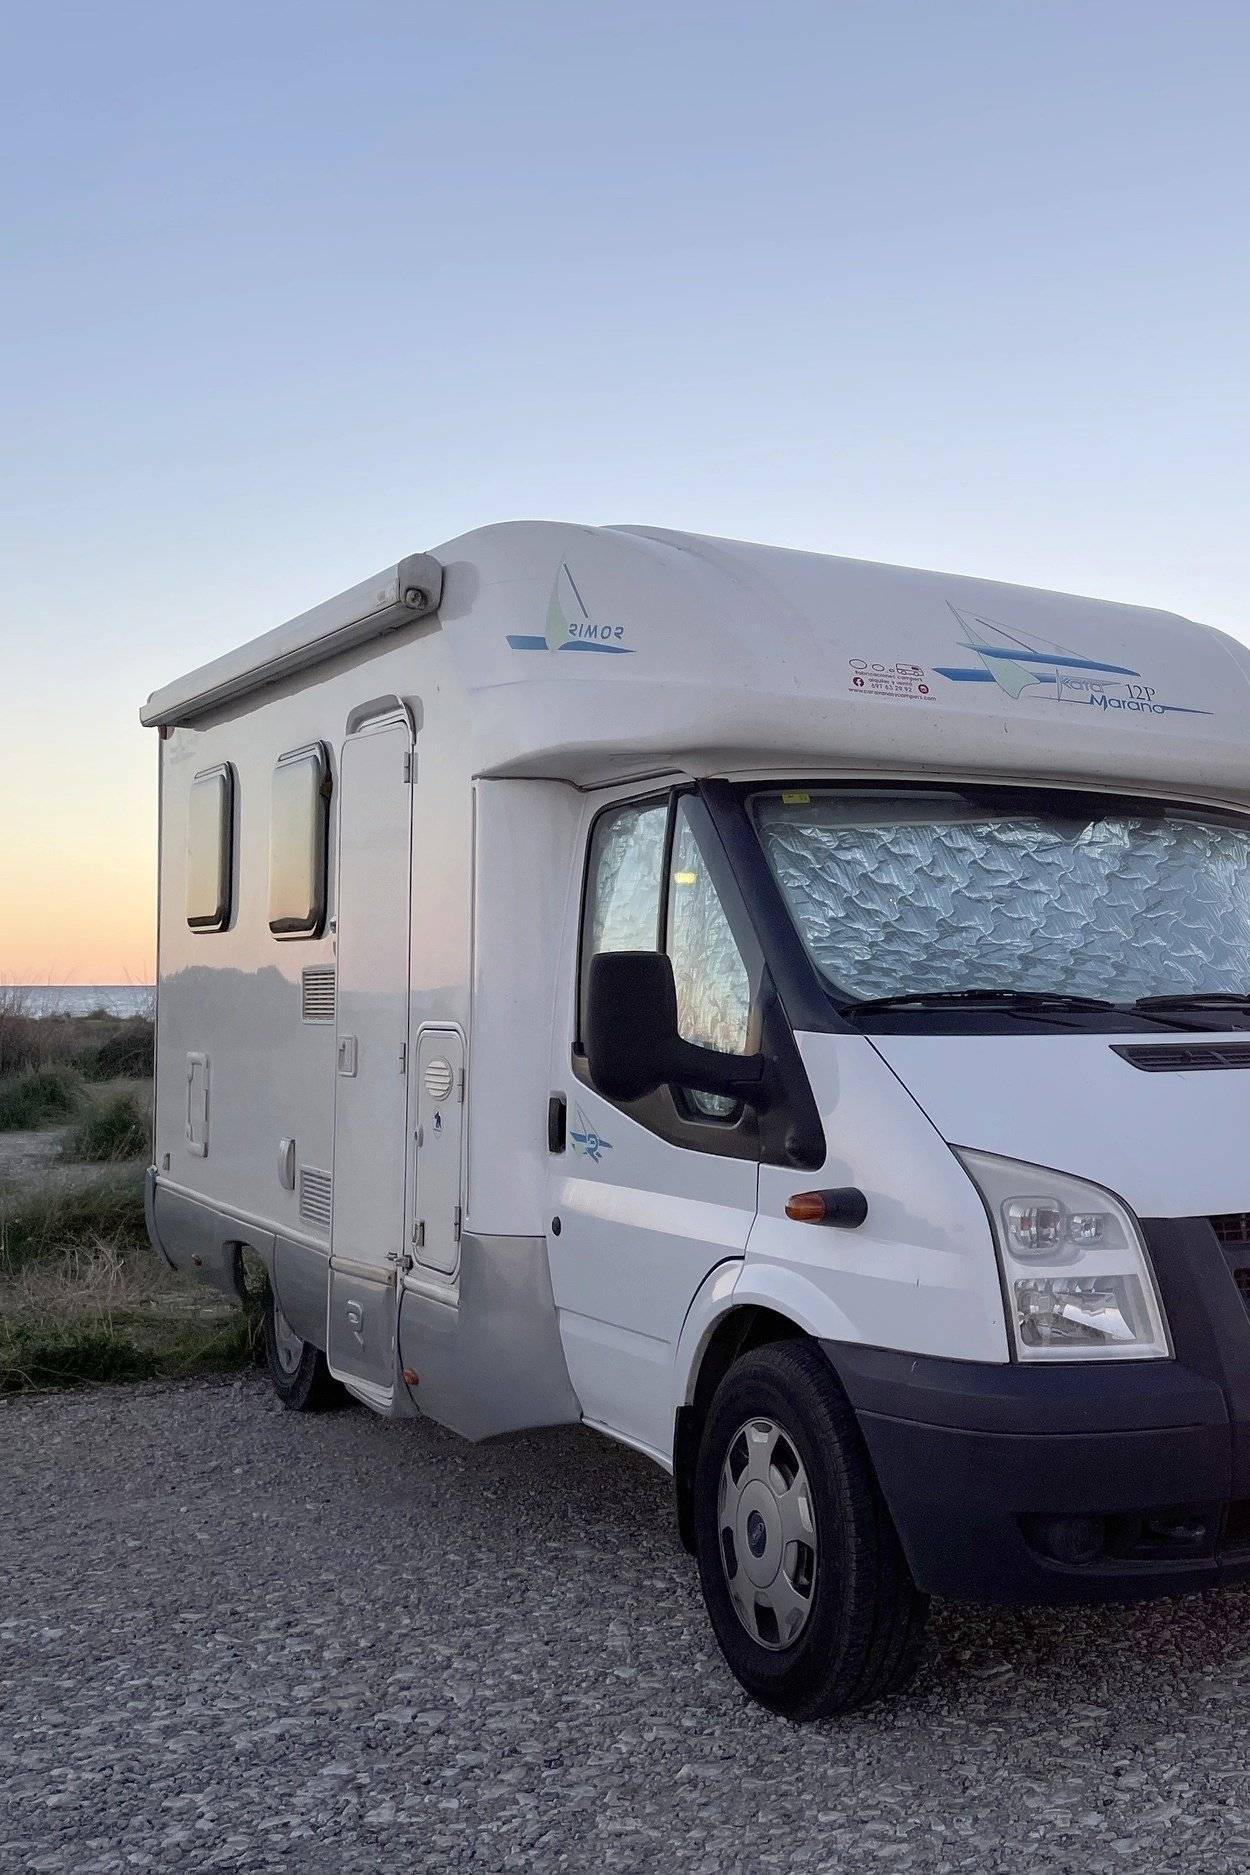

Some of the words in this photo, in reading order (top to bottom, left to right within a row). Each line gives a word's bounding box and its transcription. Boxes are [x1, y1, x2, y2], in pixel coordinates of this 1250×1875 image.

[569, 623, 624, 640] RIMOR
[1125, 683, 1156, 702] 12P
[1089, 693, 1166, 715] Marano
